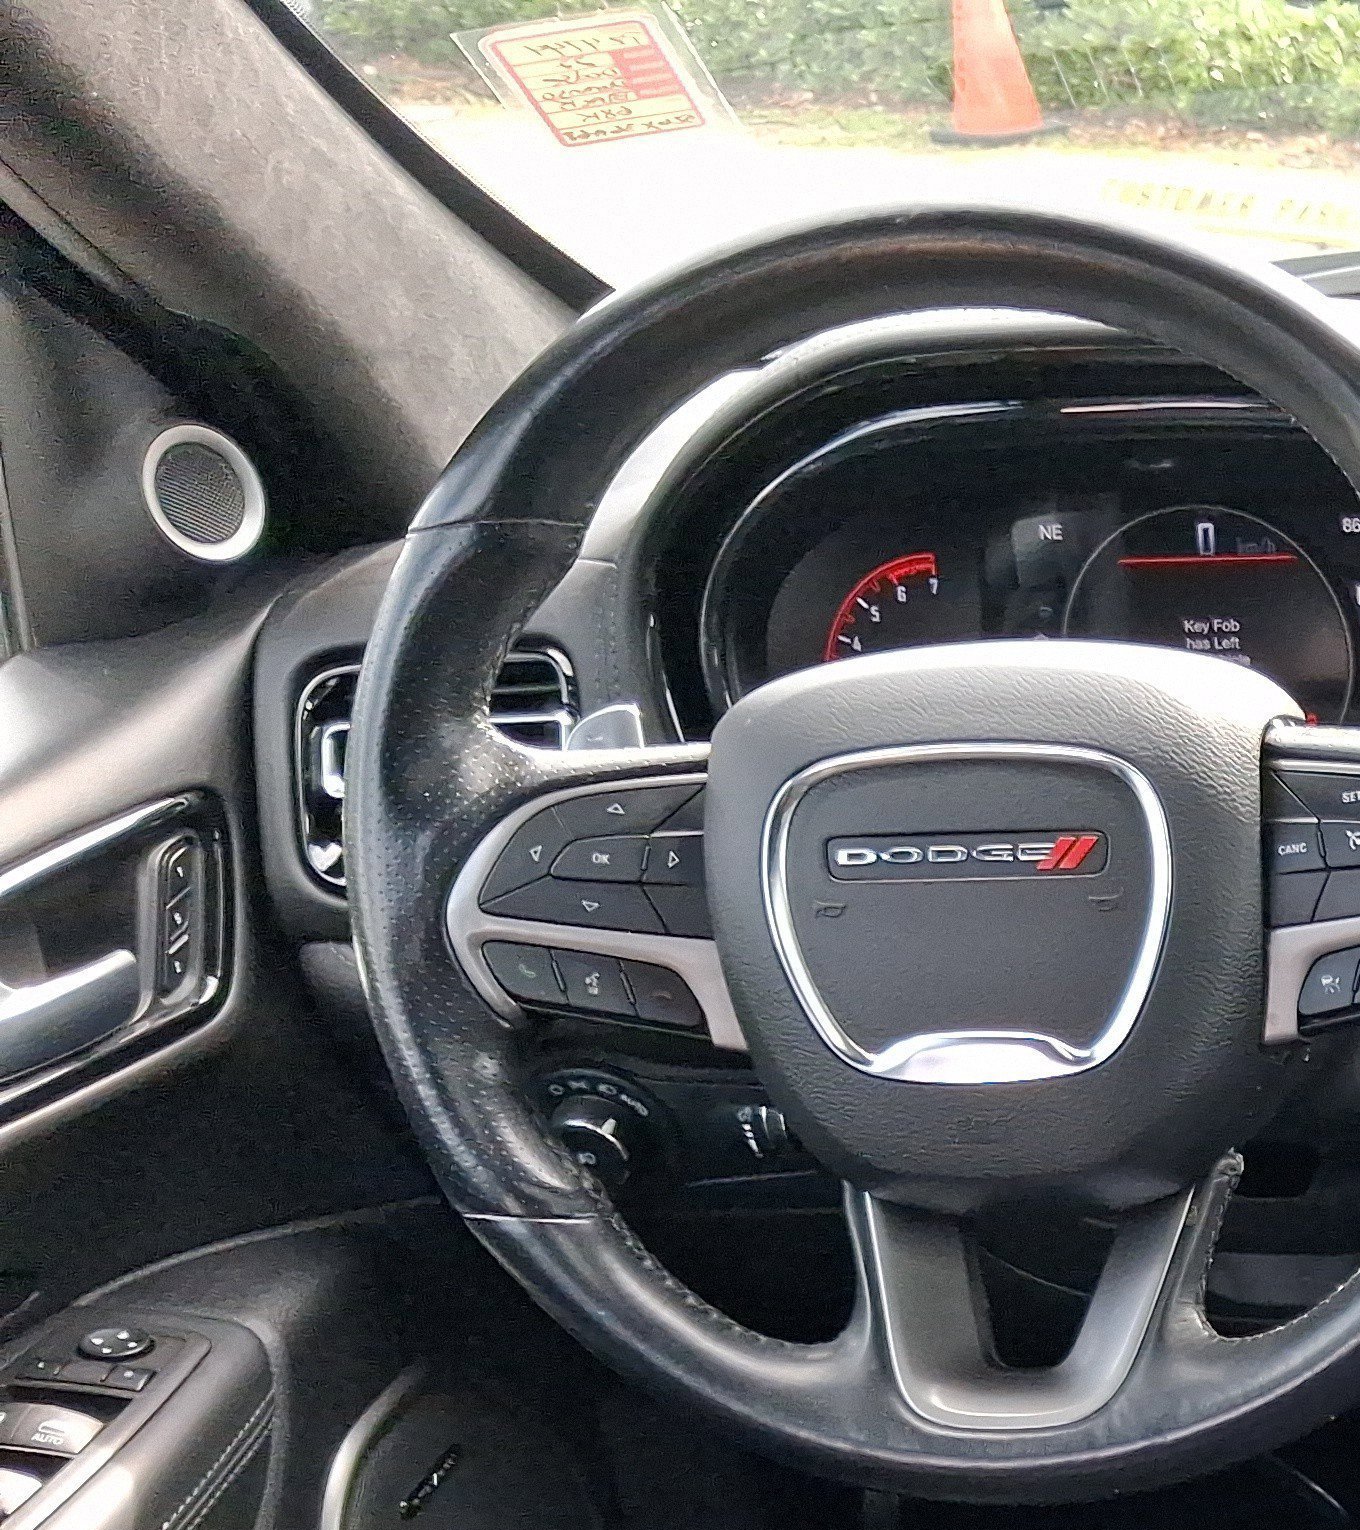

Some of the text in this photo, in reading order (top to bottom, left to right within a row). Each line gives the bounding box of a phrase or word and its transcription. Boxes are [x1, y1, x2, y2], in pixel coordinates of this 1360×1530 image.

[1038, 524, 1064, 541] NE
[869, 605, 881, 622] 5
[1183, 618, 1241, 635] Key Fob
[1186, 636, 1241, 651] has Left
[834, 842, 1055, 866] DODGE
[1277, 841, 1308, 857] CANC
[591, 853, 610, 866] OK
[31, 1432, 65, 1446] AUTO
